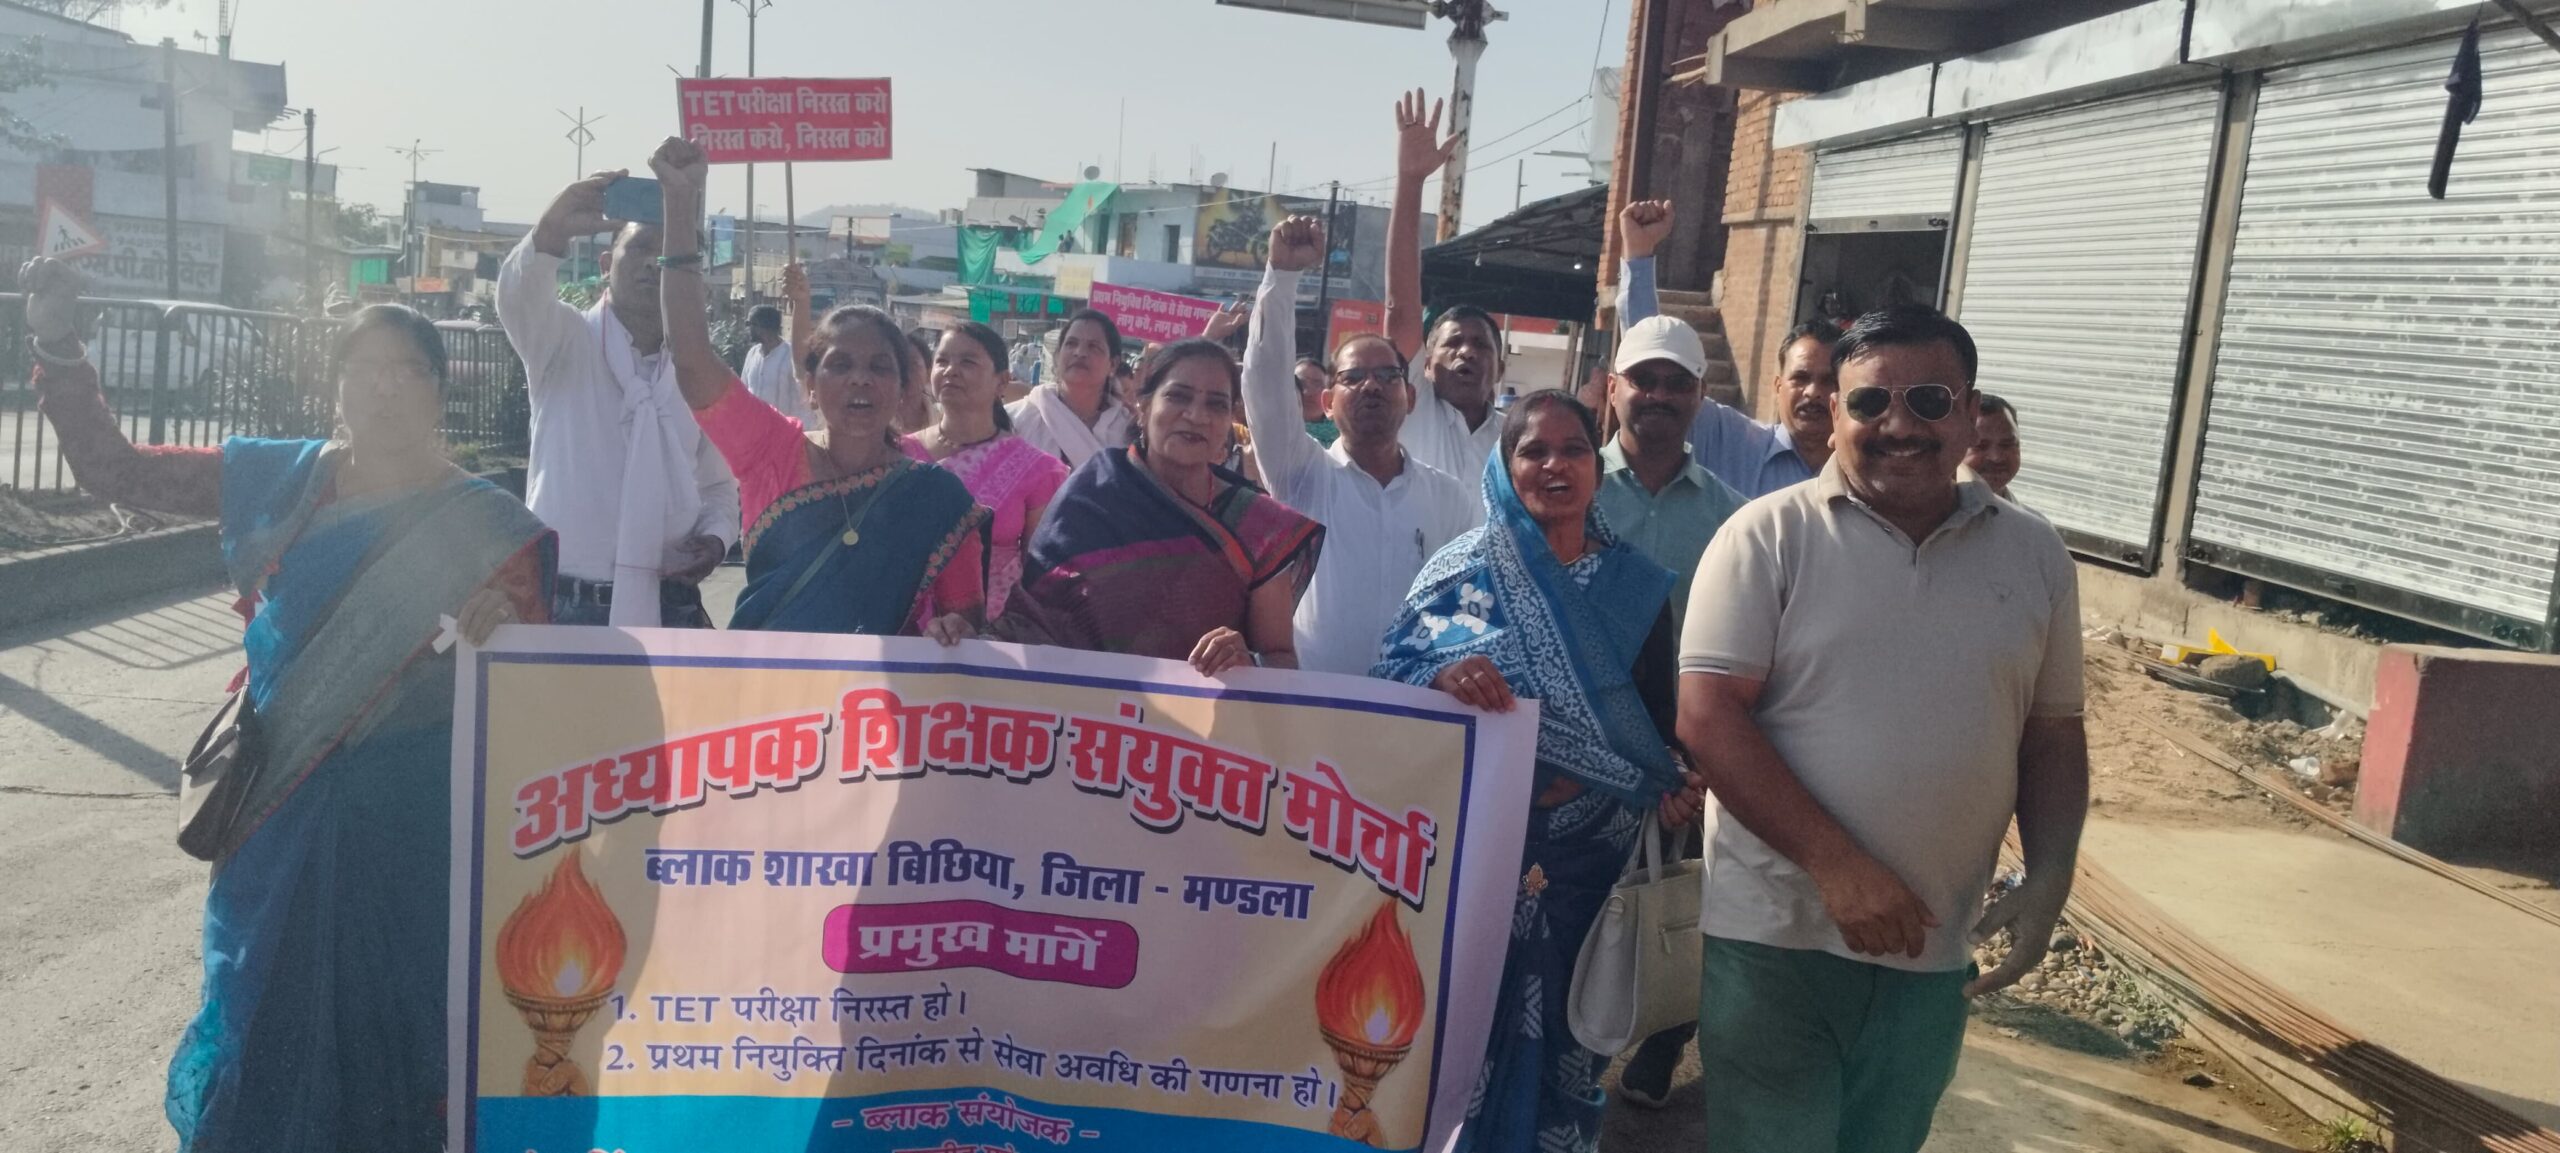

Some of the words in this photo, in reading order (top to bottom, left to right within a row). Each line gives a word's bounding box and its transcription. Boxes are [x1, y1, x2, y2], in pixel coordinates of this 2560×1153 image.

[685, 90, 735, 116] TET
[736, 87, 793, 115] परीक्षा
[796, 87, 851, 115] निरस्त
[854, 87, 888, 114] करो
[796, 122, 851, 150] निरस्त
[854, 122, 886, 149] करो
[514, 711, 825, 850] अध्यापक
[840, 687, 1056, 774] शिक्षक
[1069, 702, 1273, 823] संयुक्त
[1285, 760, 1432, 897] मोर्चा
[645, 848, 755, 887] ब्लाक
[763, 849, 878, 888] शाखा
[887, 838, 1026, 900] बिछिया,
[1041, 851, 1146, 905] जिला
[1183, 874, 1315, 920] मण्डला
[858, 920, 994, 967] प्रमुख
[1003, 924, 1108, 971] मागें
[609, 994, 638, 1022] 1.
[650, 995, 721, 1023] TET
[731, 986, 821, 1028] परीक्षा
[829, 986, 914, 1023] निरस्त
[606, 1044, 635, 1071] 2.
[646, 1043, 724, 1071] प्रथम
[731, 1035, 847, 1081] नियुक्ति
[855, 1032, 949, 1074] दिनांक
[956, 1027, 984, 1064] से
[991, 1033, 1046, 1078] सेवा
[1055, 1049, 1143, 1087] अवधि
[1148, 1058, 1192, 1093] की
[1199, 1068, 1285, 1099] गणना
[860, 1103, 950, 1130] ब्लाक
[956, 1093, 1073, 1143] संयोजक
